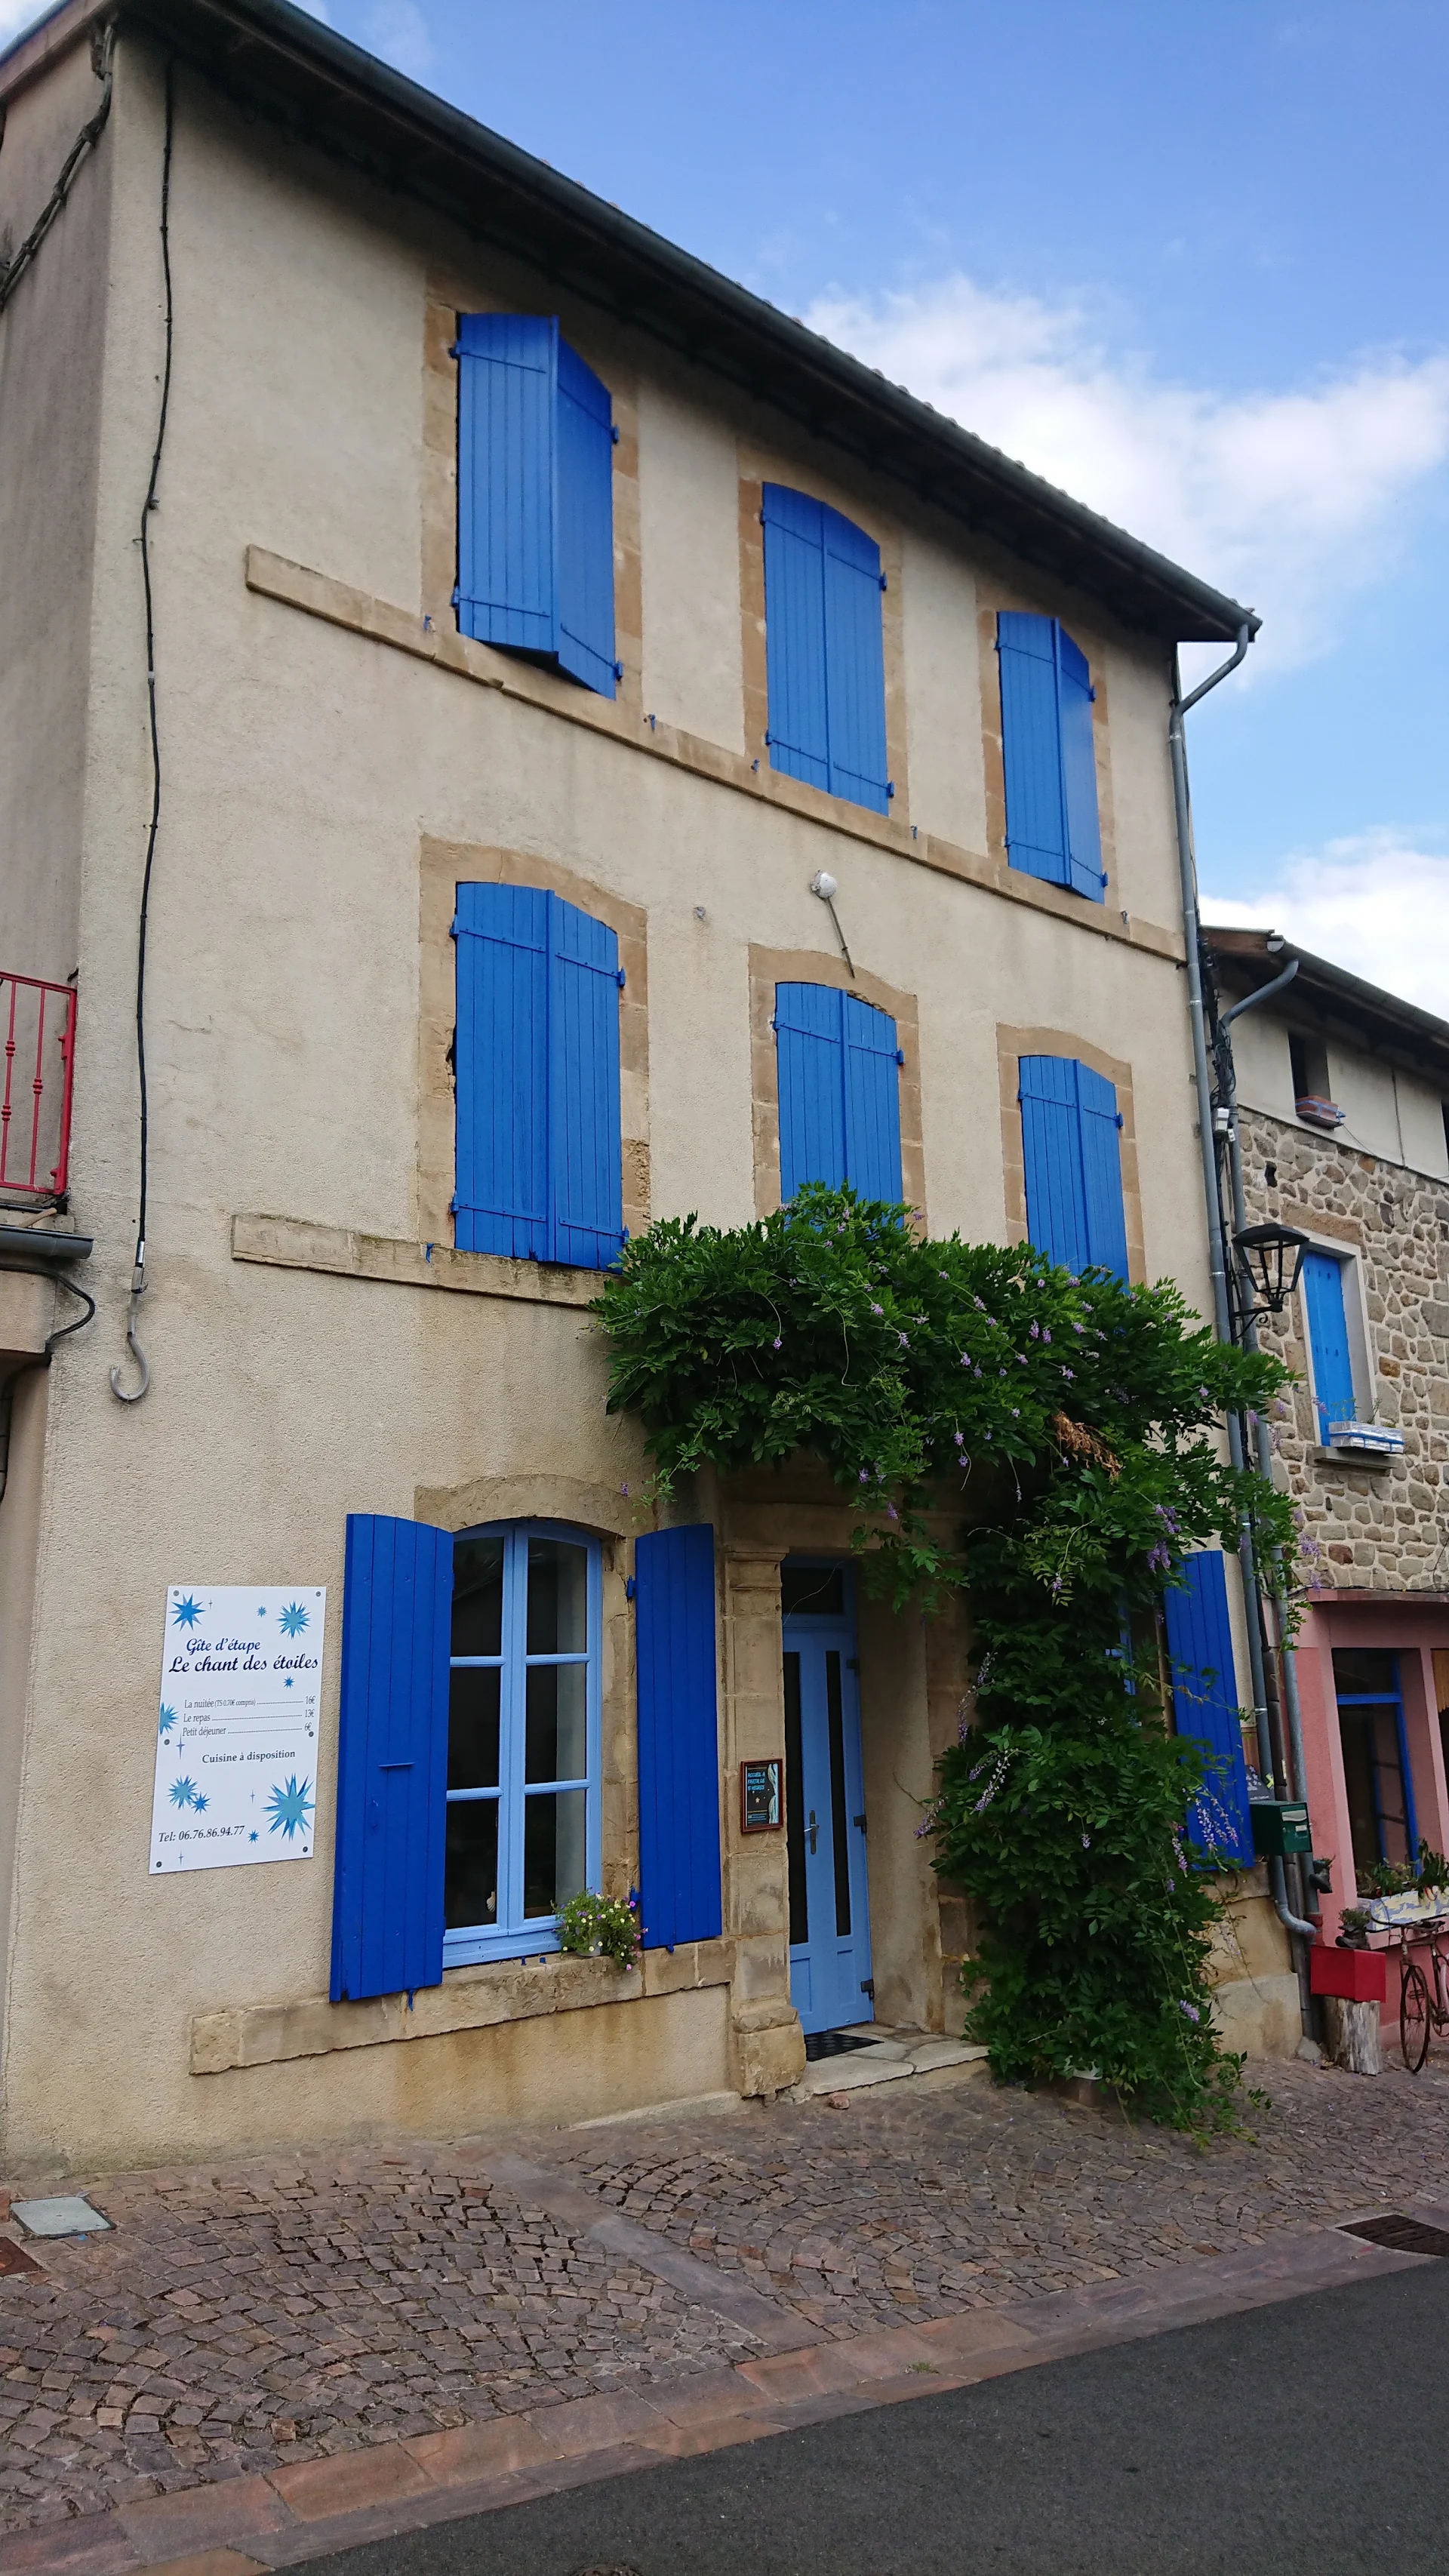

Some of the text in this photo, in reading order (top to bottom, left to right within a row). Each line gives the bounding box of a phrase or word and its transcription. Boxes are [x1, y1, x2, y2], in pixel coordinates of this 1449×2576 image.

[186, 1639, 211, 1655] Gîte
[168, 1653, 318, 1673] Le chant des étoiles
[184, 1699, 192, 1709] La
[194, 1698, 214, 1708] nuitée
[236, 1698, 257, 1707] compris)
[305, 1695, 316, 1705] 16€
[183, 1709, 315, 1725] Le repas 13€
[183, 1722, 312, 1738] Petit déjeuner 6€
[202, 1750, 296, 1763] Cuisine à disposition
[158, 1825, 245, 1842] Tel: 06.76.86.94.77
